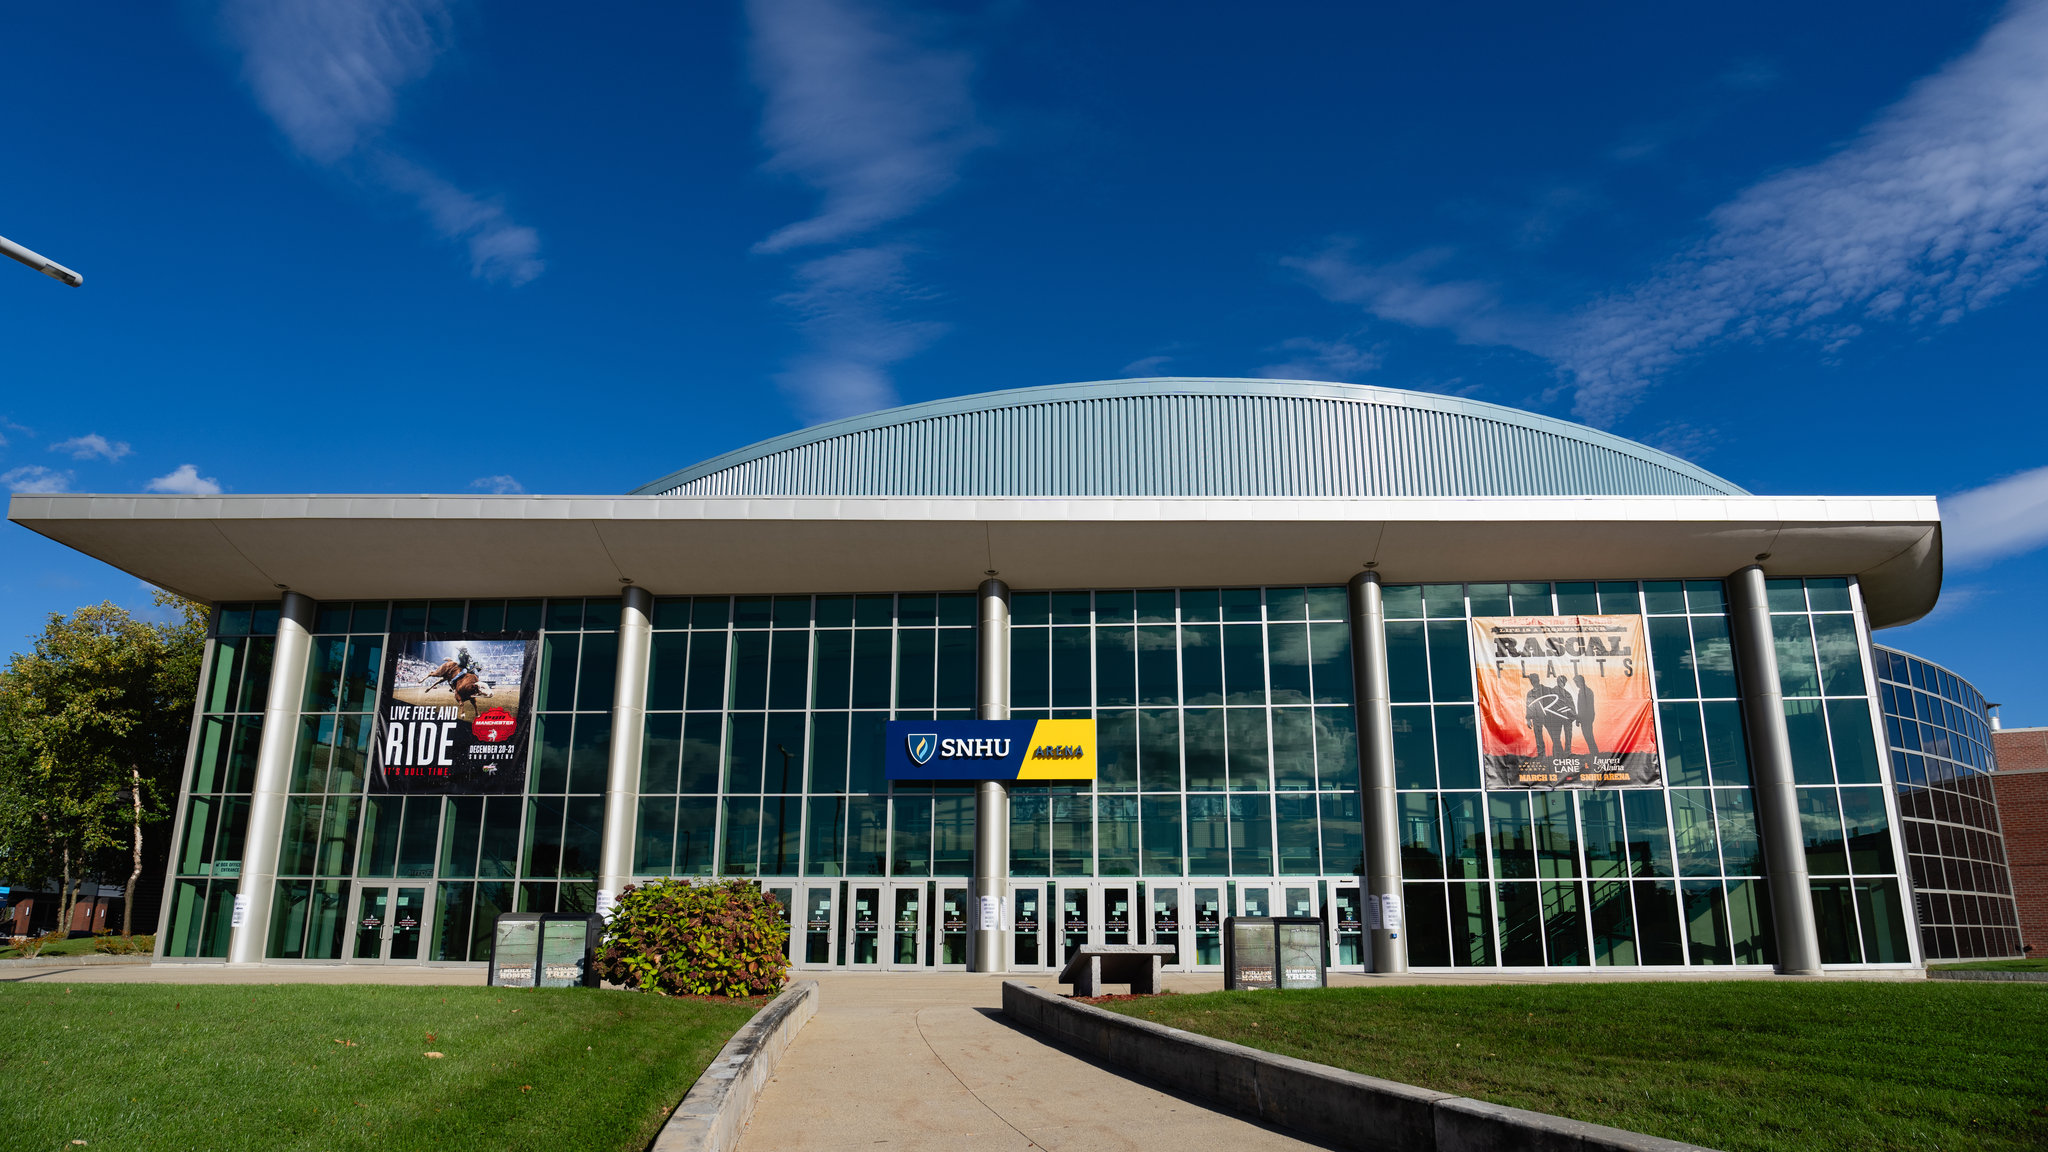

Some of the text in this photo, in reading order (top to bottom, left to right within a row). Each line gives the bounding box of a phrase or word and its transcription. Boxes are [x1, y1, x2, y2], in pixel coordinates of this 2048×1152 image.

[1494, 636, 1631, 657] RASCAL
[1496, 658, 1633, 678] FLATTS
[390, 706, 458, 720] LIVE FREE AND
[385, 722, 457, 766] RIDE
[941, 738, 1011, 757] SNHU
[469, 745, 498, 754] DECEMBER
[1034, 745, 1084, 757] ARENA
[1552, 758, 1580, 766] CHRIS
[1593, 755, 1620, 765] Lauren
[384, 767, 401, 776] IT'S
[404, 767, 424, 776] BULL
[1554, 765, 1580, 773] LANE
[1593, 763, 1625, 773] Alaina
[1580, 773, 1602, 781] SNHU
